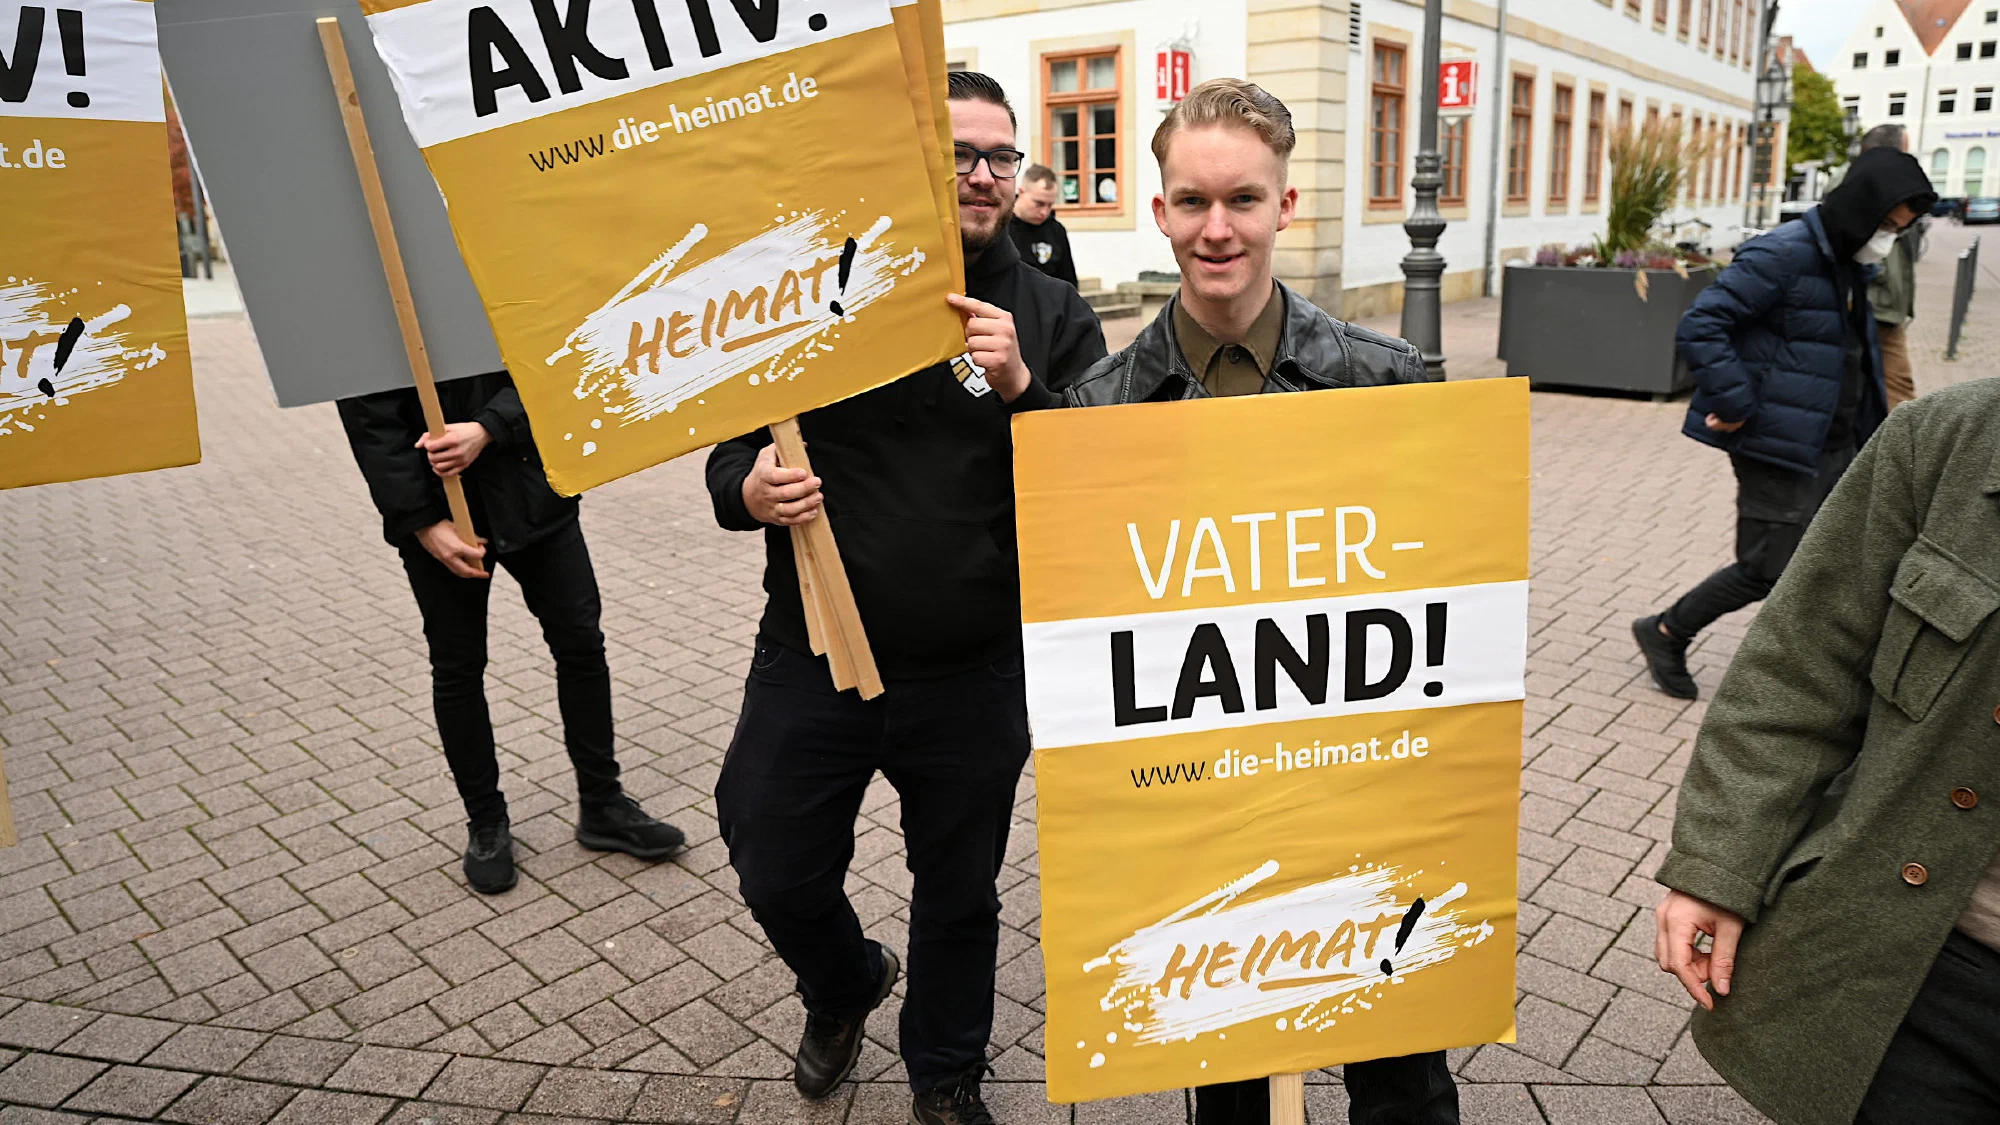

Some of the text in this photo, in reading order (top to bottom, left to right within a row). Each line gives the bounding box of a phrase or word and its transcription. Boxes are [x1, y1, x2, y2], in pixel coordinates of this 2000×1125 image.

[529, 72, 820, 172] www.die-heimat.de
[623, 236, 857, 376] HEIMAT!
[1126, 504, 1425, 600] VATER-
[1110, 602, 1448, 727] LAND!
[1130, 730, 1430, 789] www.die-heimat.de
[1153, 896, 1426, 1001] HEIMAT!
